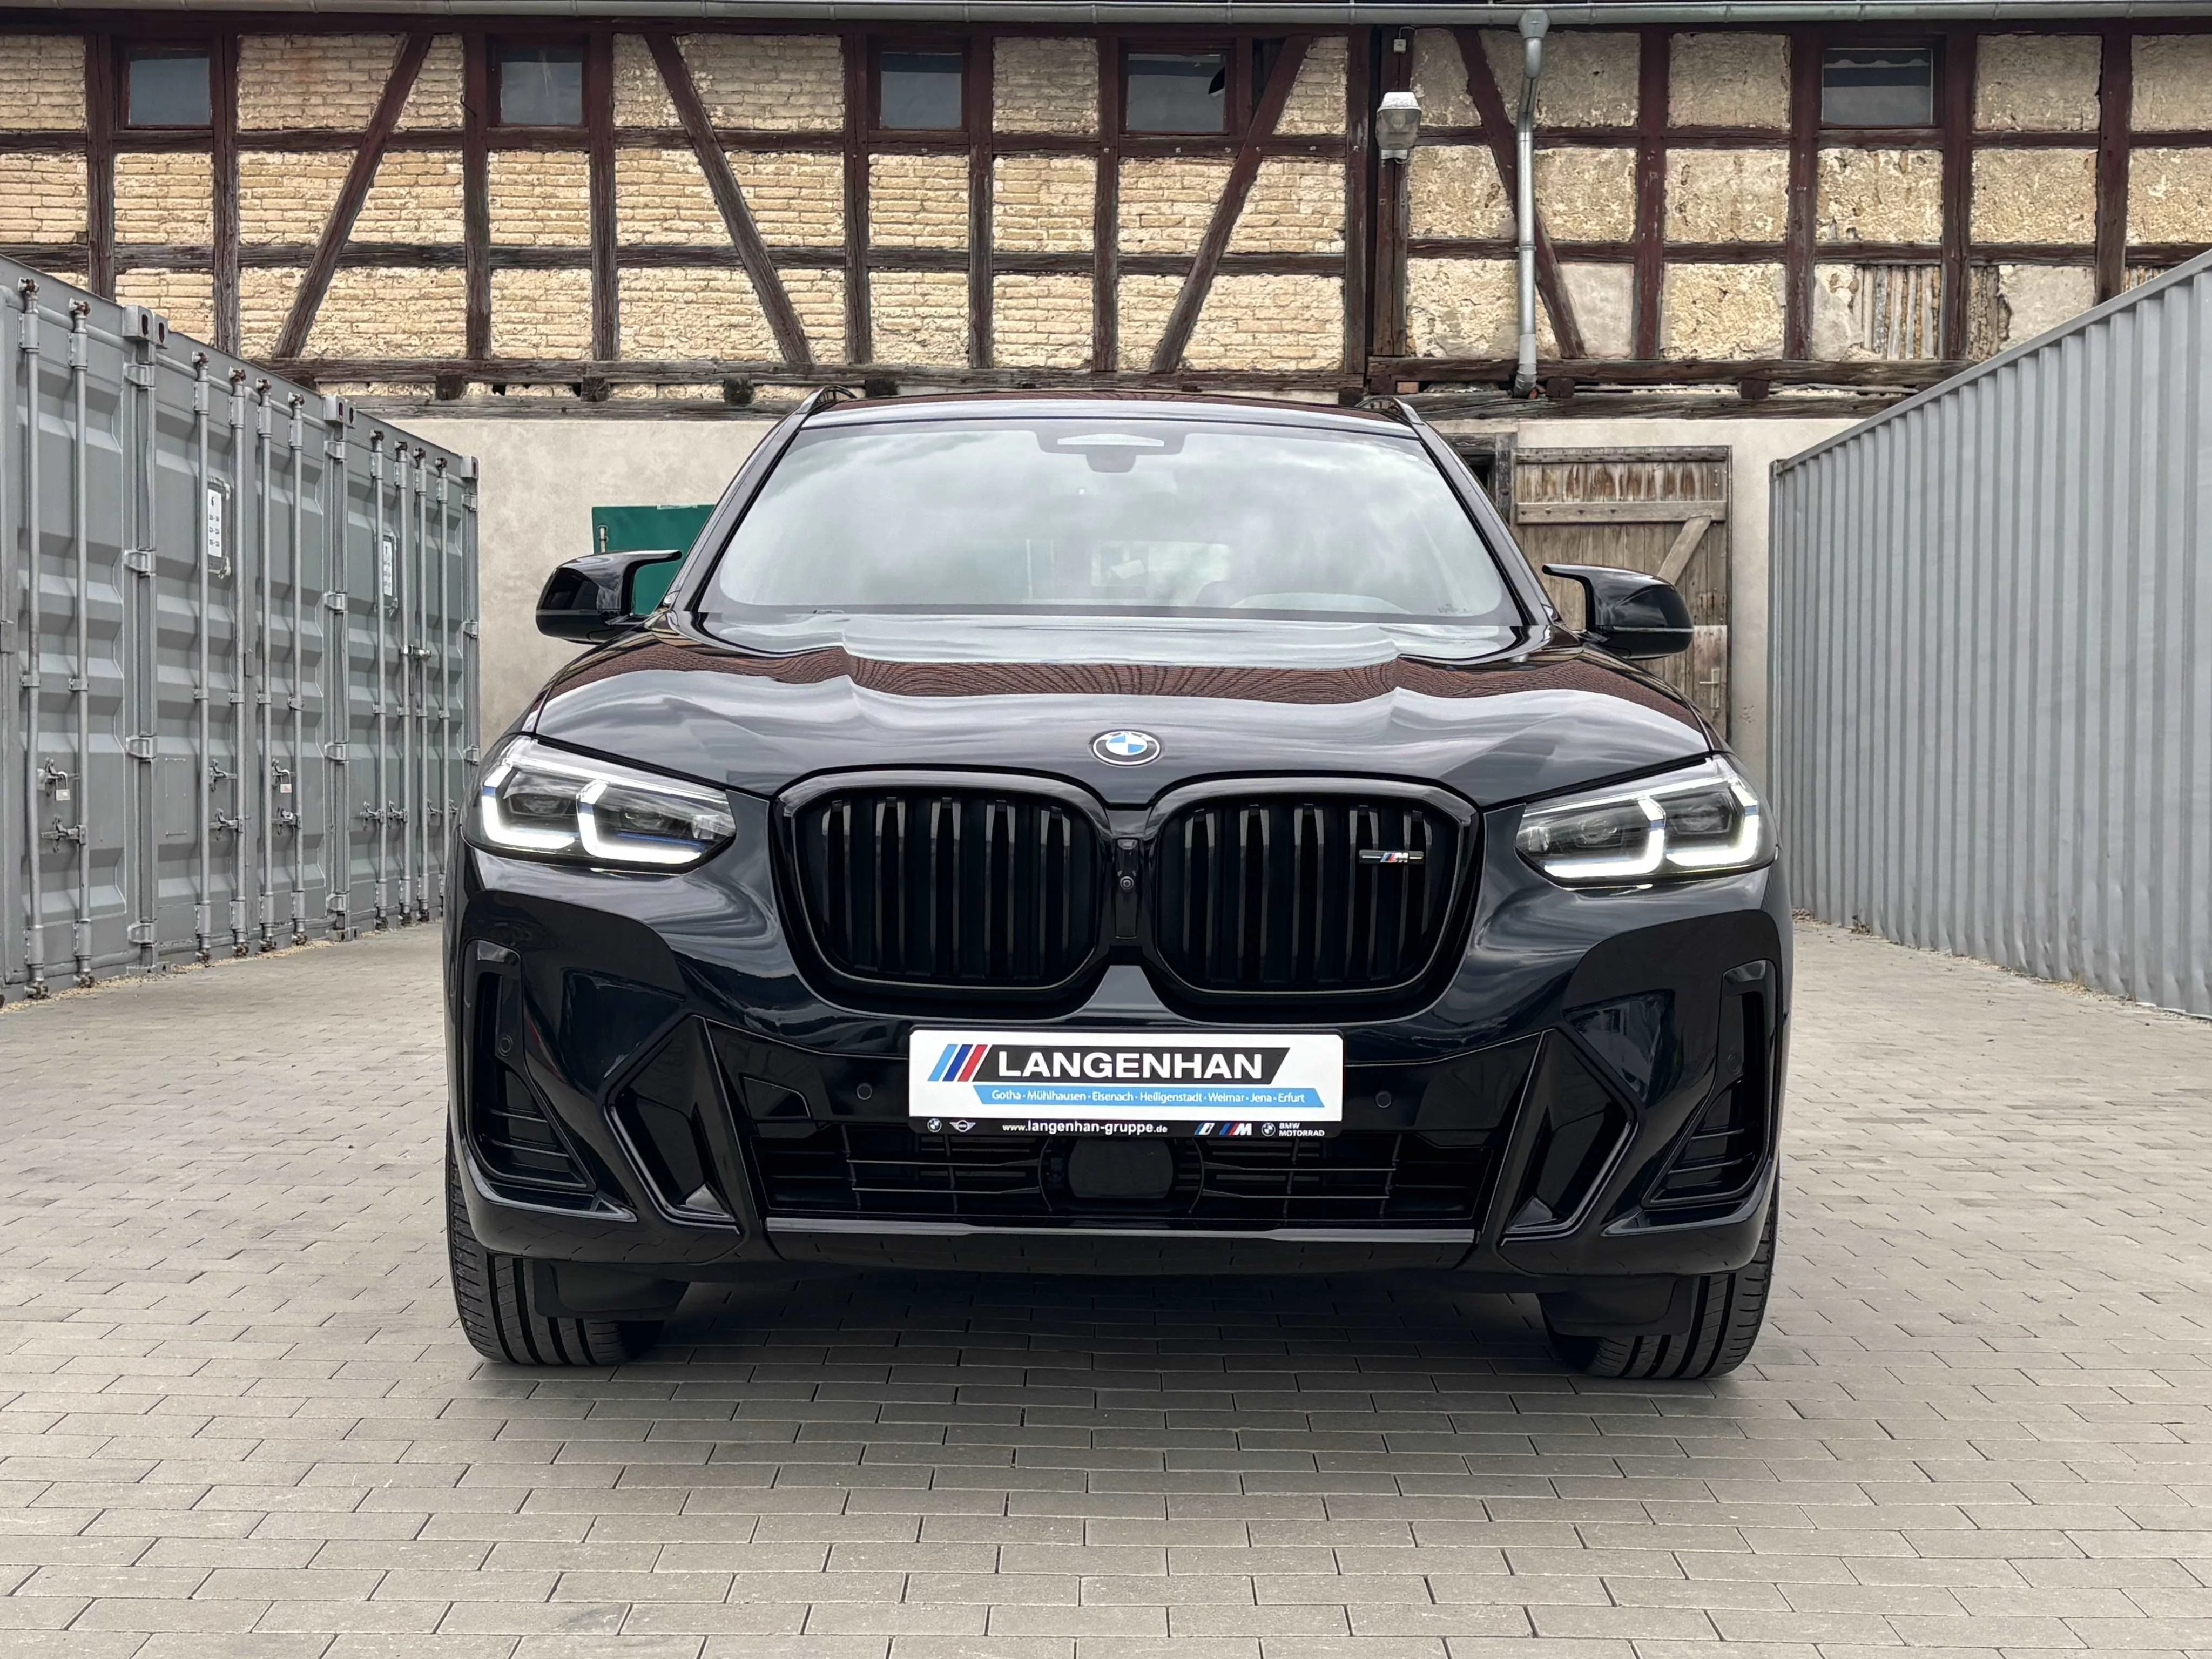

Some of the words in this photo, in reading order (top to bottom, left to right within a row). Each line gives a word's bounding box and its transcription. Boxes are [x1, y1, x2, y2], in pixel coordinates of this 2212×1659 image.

[999, 1051, 1262, 1080] LANGENHAN
[992, 1089, 1022, 1100] Gotha
[1027, 1090, 1087, 1101] Mühlhausen
[1092, 1091, 1134, 1102] Eisenach
[1139, 1091, 1202, 1103] Heiligenstadt
[1208, 1092, 1244, 1103] Weimar
[1251, 1093, 1272, 1103] Jena
[1278, 1093, 1305, 1103] Erfurt
[1002, 1120, 1168, 1134] www.langenhan-gruppe.de
